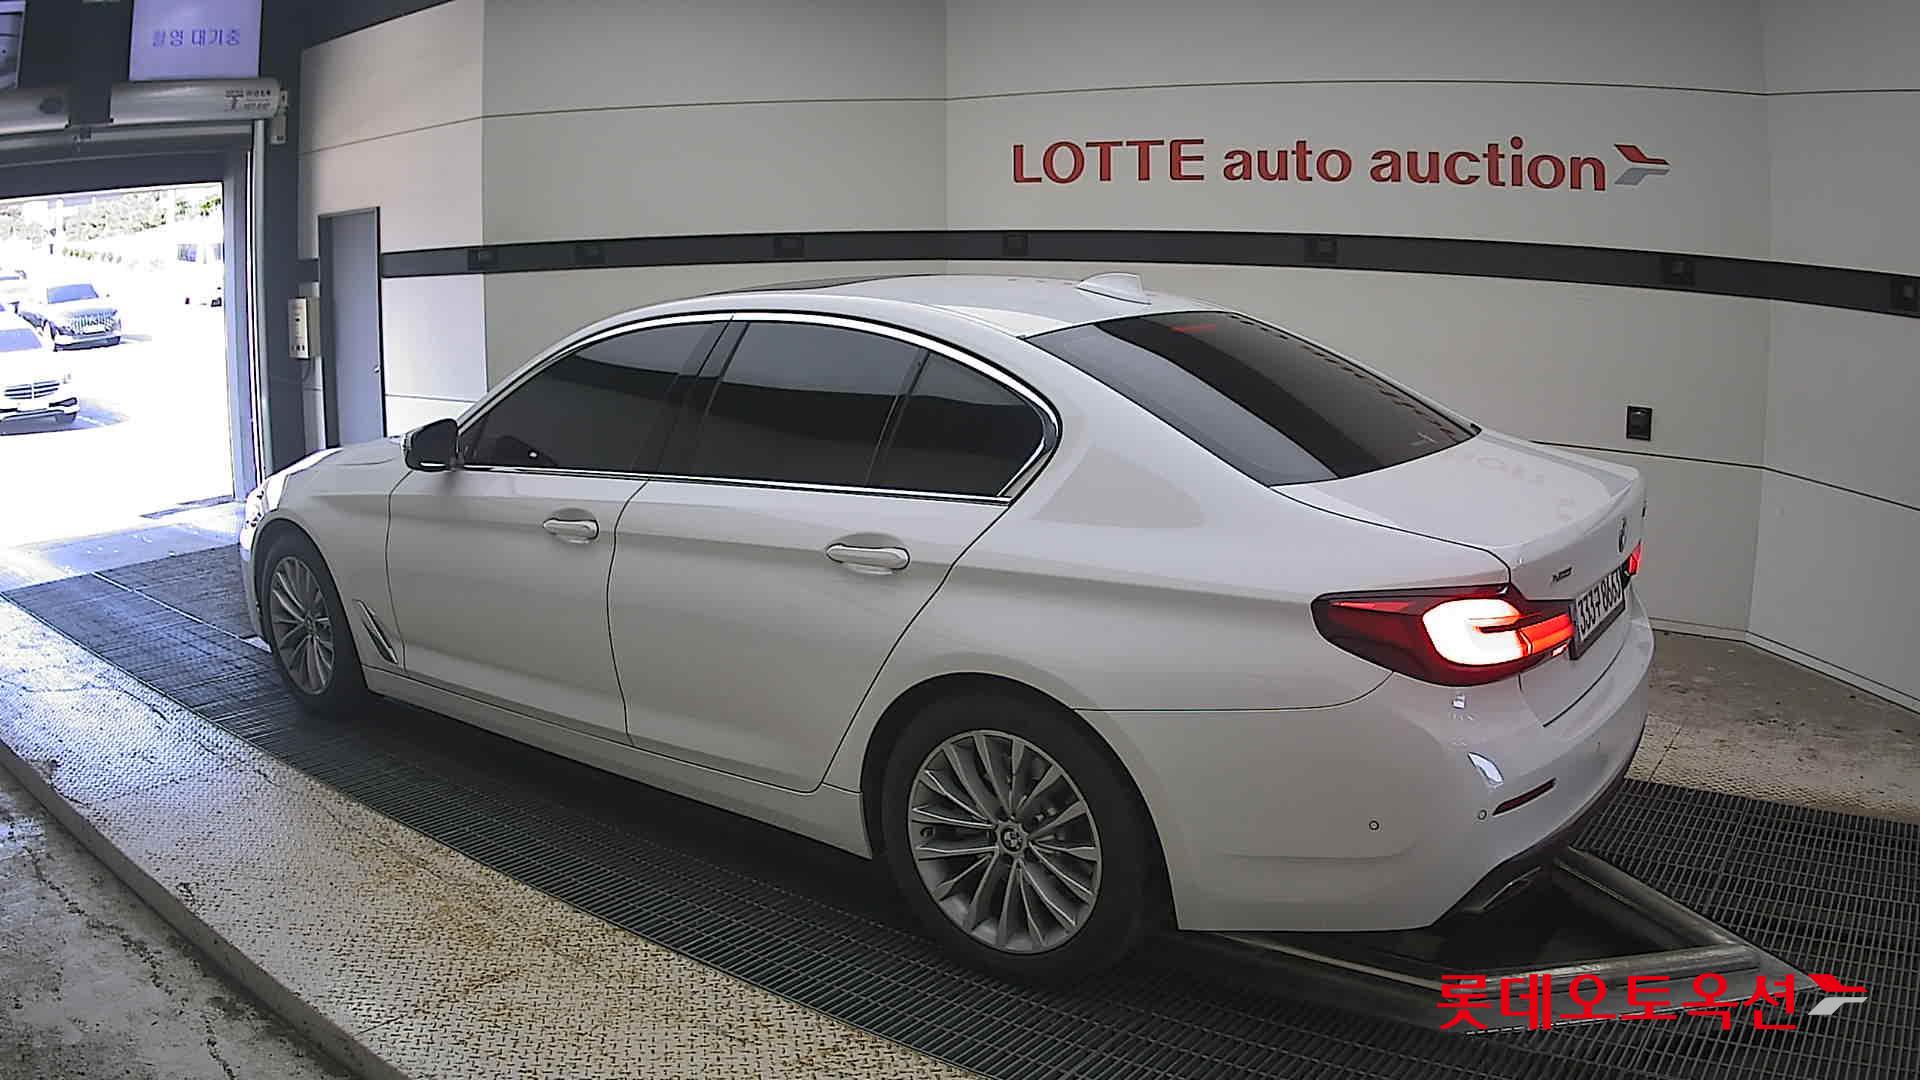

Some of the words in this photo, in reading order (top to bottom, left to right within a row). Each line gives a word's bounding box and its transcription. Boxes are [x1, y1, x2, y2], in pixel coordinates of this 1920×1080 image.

[1012, 139, 1205, 184] LOTTE
[1222, 140, 1353, 182] auto
[1369, 137, 1607, 191] auction
